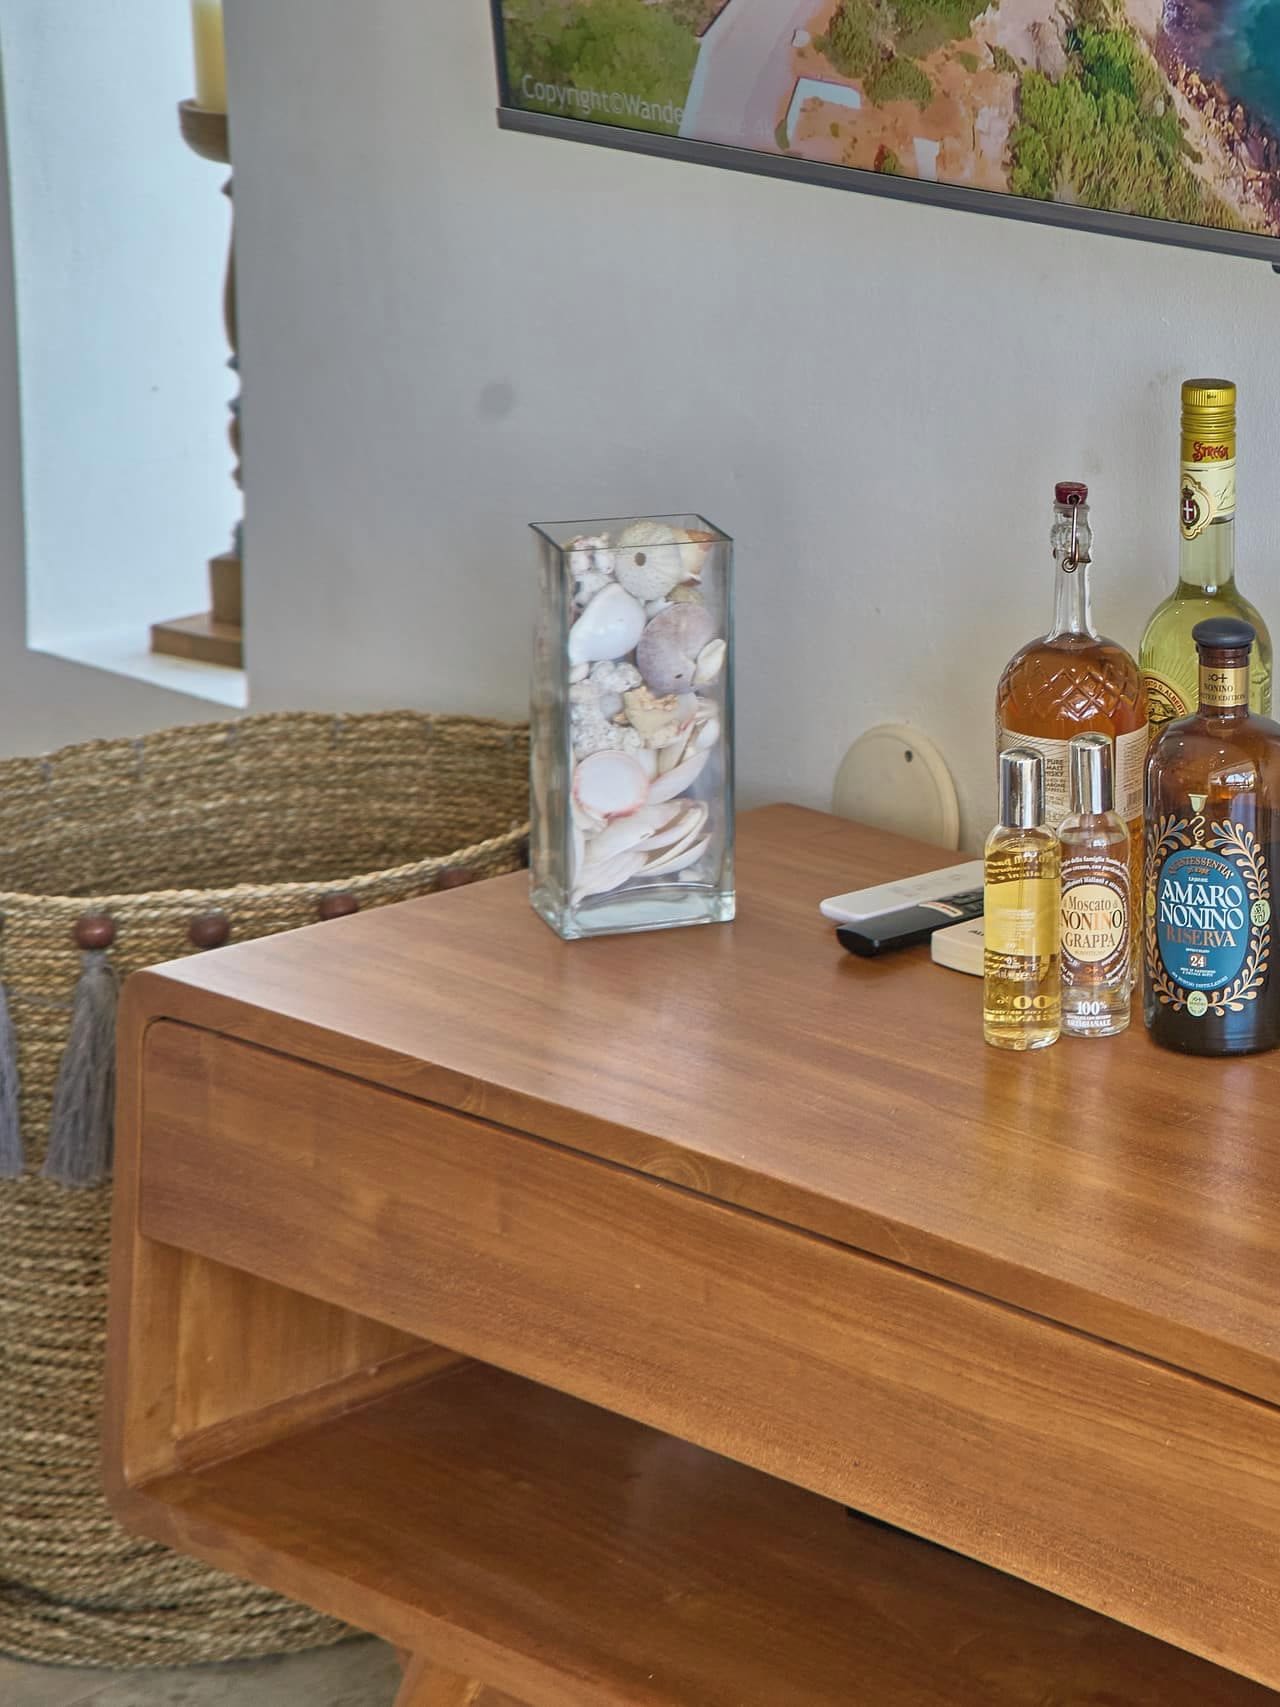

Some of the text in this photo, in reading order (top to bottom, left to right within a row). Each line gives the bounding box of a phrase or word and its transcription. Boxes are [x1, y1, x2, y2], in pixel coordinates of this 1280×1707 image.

[1068, 895, 1112, 912] Moscato
[1161, 878, 1243, 909] AMARO
[1060, 908, 1123, 931] NONINO
[1159, 900, 1244, 930] NONINO
[1064, 931, 1116, 949] GRAPPA
[1166, 924, 1238, 948] RISERVA
[1190, 955, 1205, 968] 24
[1076, 1001, 1108, 1016] 100%
